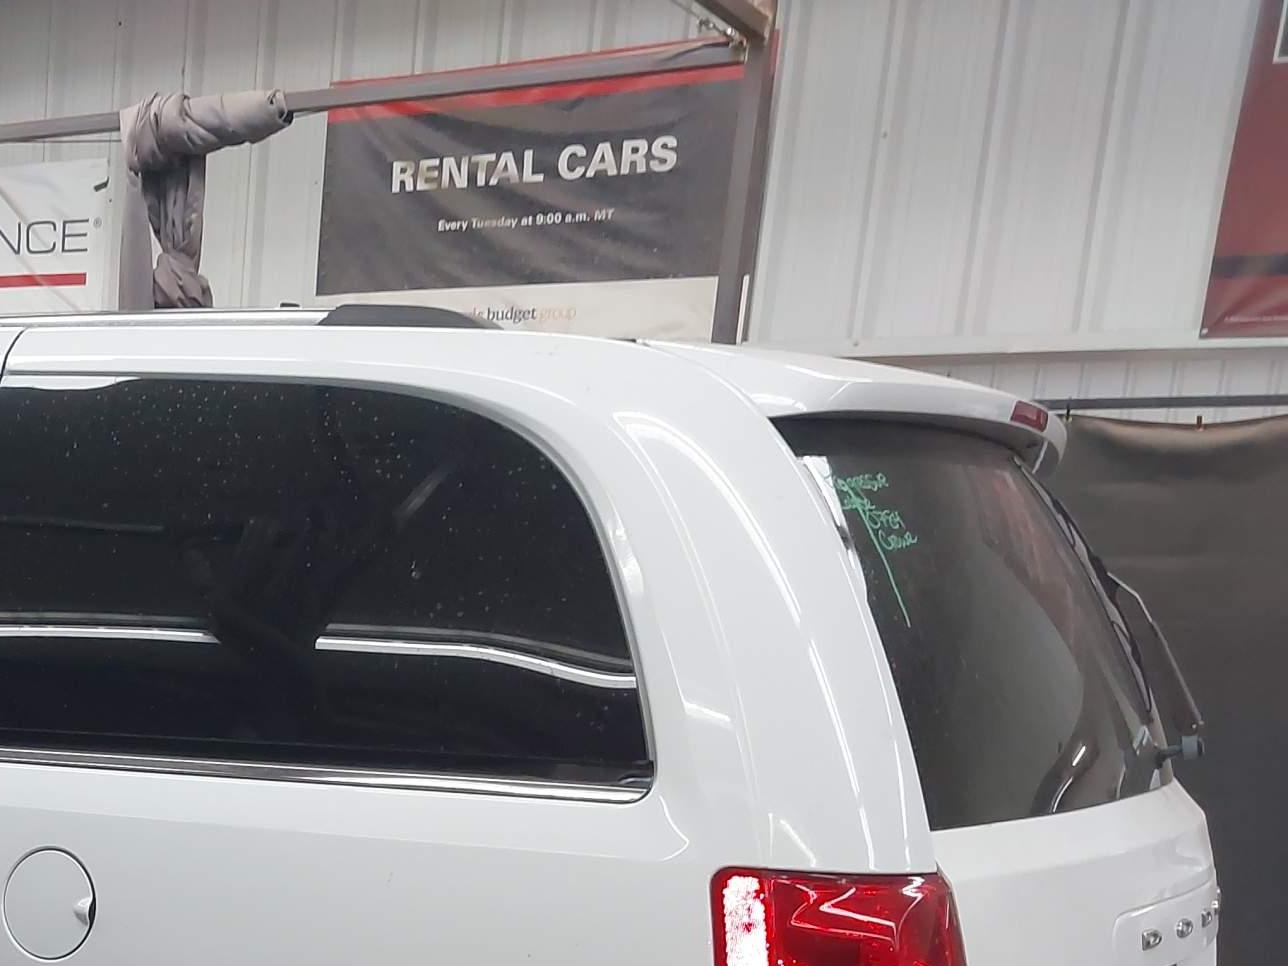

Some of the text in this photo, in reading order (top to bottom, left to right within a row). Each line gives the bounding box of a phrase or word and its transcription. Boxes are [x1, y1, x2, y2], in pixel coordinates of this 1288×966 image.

[390, 135, 679, 193] RENTAL CARS
[437, 218, 469, 232] Every
[471, 215, 519, 229] Tuesday
[520, 215, 533, 227] at
[564, 212, 591, 224] a.m.
[593, 208, 615, 221] MT
[486, 306, 537, 324] budget
